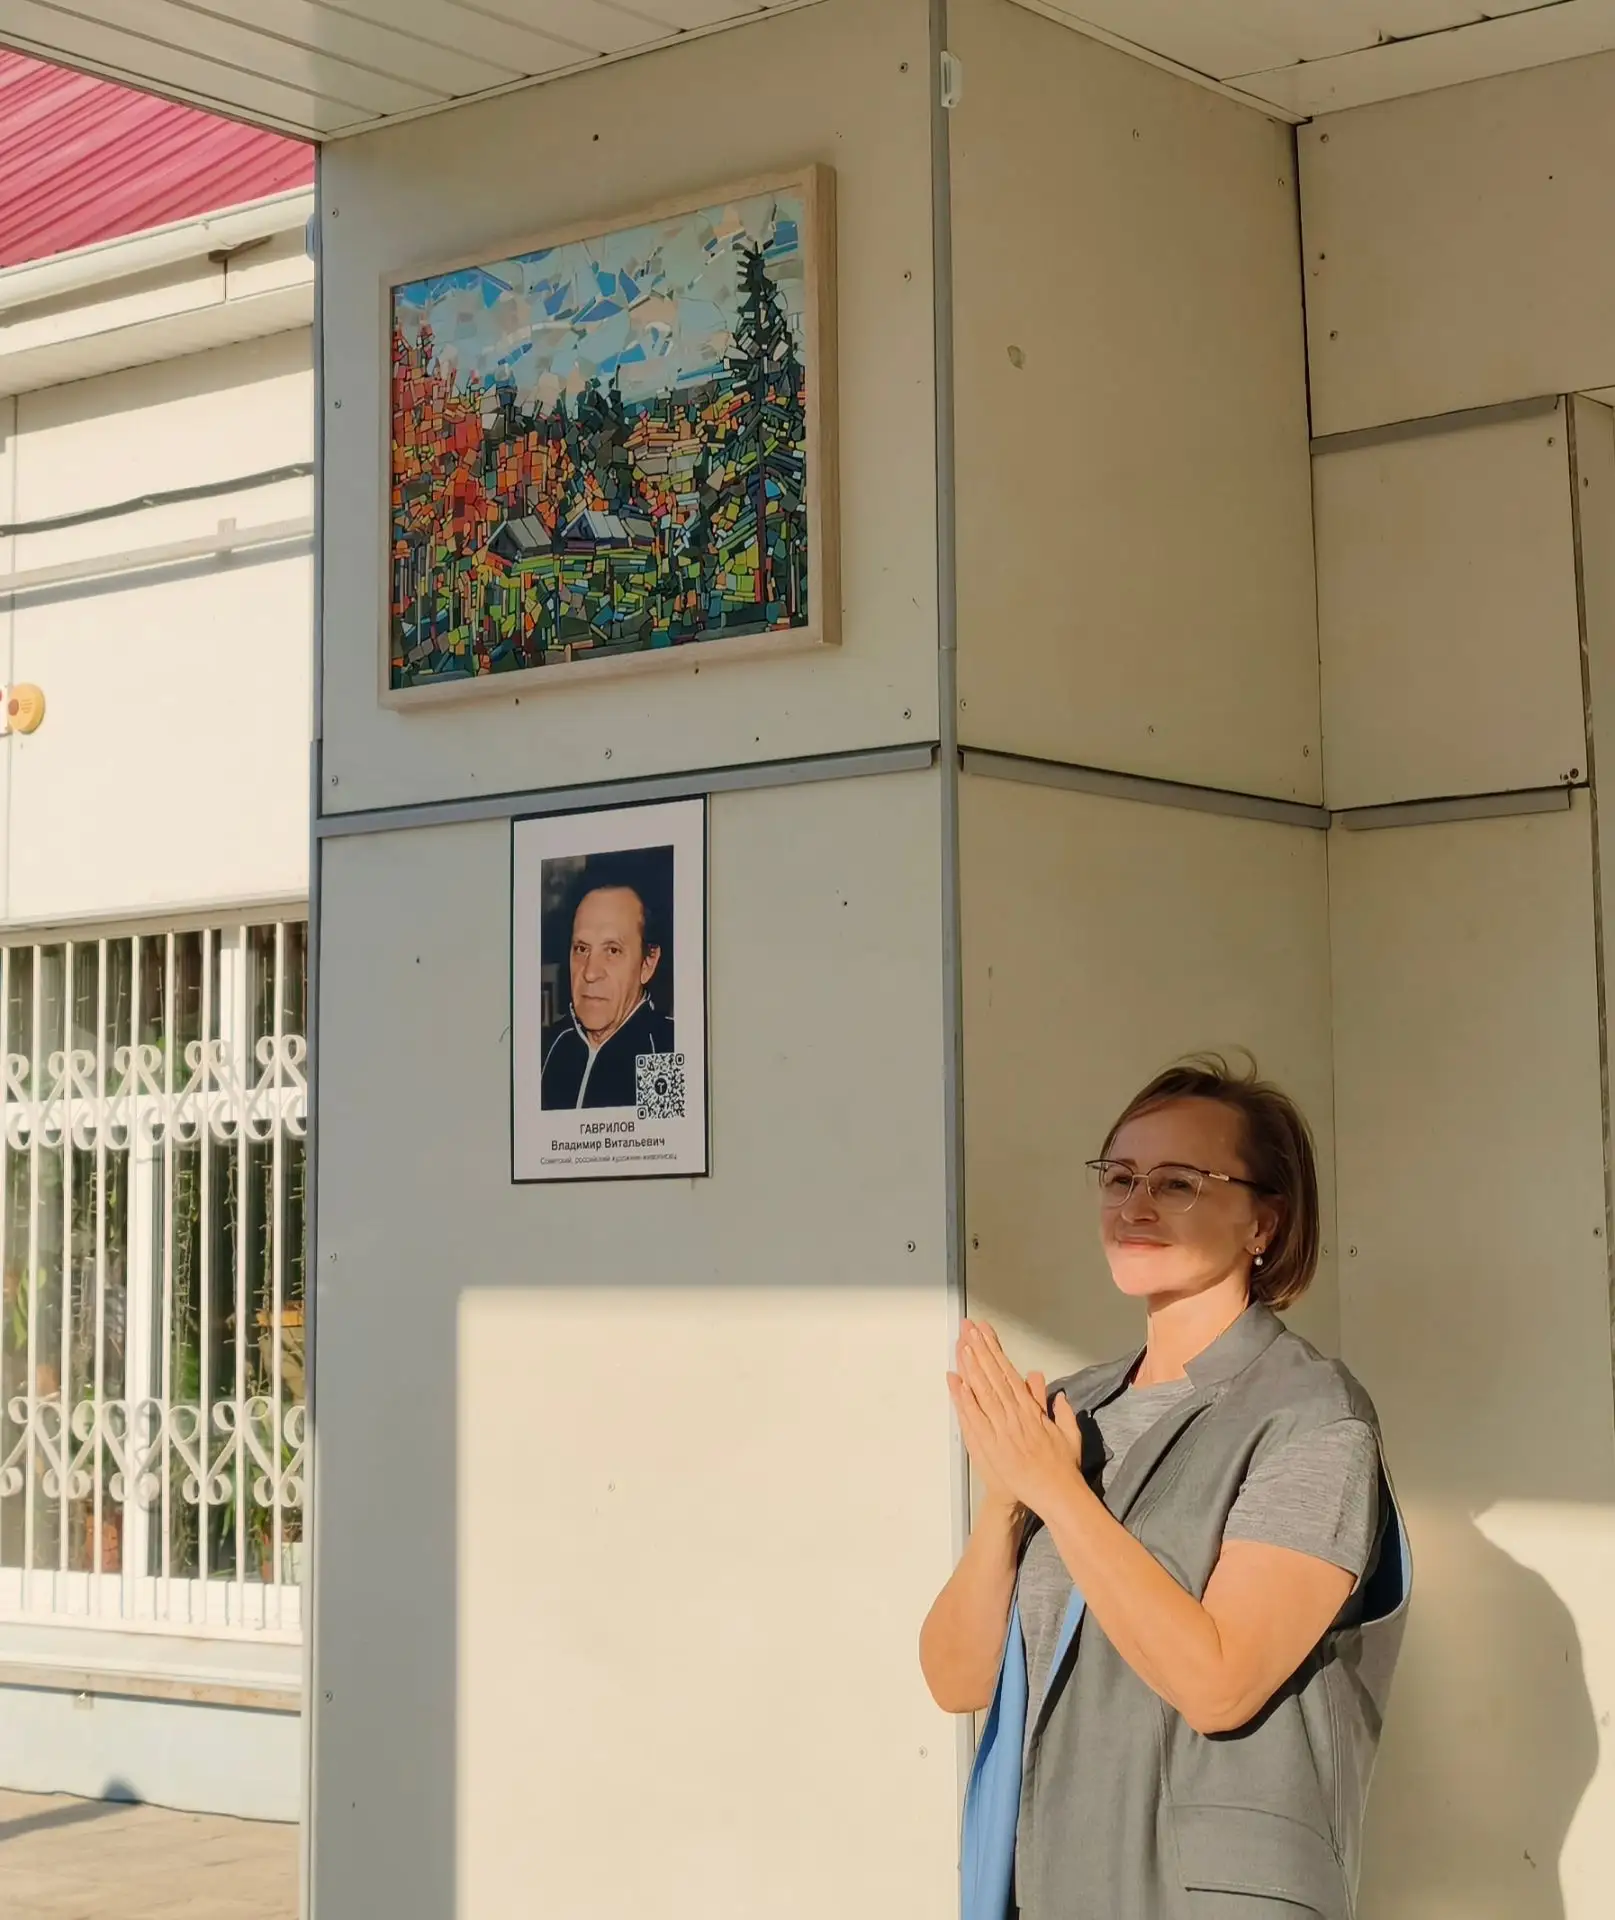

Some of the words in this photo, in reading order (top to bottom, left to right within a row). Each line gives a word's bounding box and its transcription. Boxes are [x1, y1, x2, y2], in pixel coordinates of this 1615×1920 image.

[579, 1121, 635, 1135] ГАВРИЛОВ
[551, 1139, 602, 1151] Владимир
[604, 1136, 665, 1149] Витальевич
